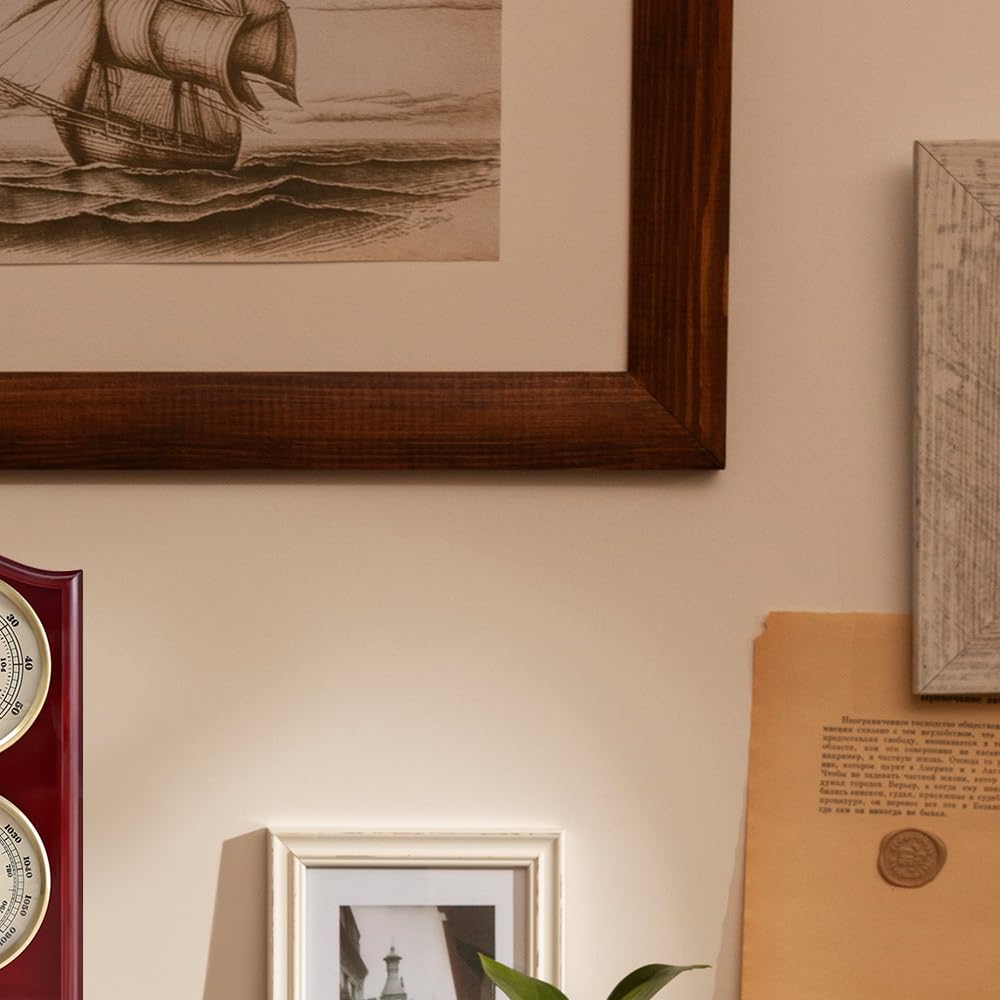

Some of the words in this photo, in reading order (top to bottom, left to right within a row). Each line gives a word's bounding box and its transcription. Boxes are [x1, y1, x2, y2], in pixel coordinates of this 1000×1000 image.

[6, 613, 19, 628] 30
[24, 655, 33, 671] 40
[11, 701, 24, 717] 50
[4, 823, 22, 844] 1030
[22, 856, 33, 879] 1040
[20, 895, 32, 917] 1050
